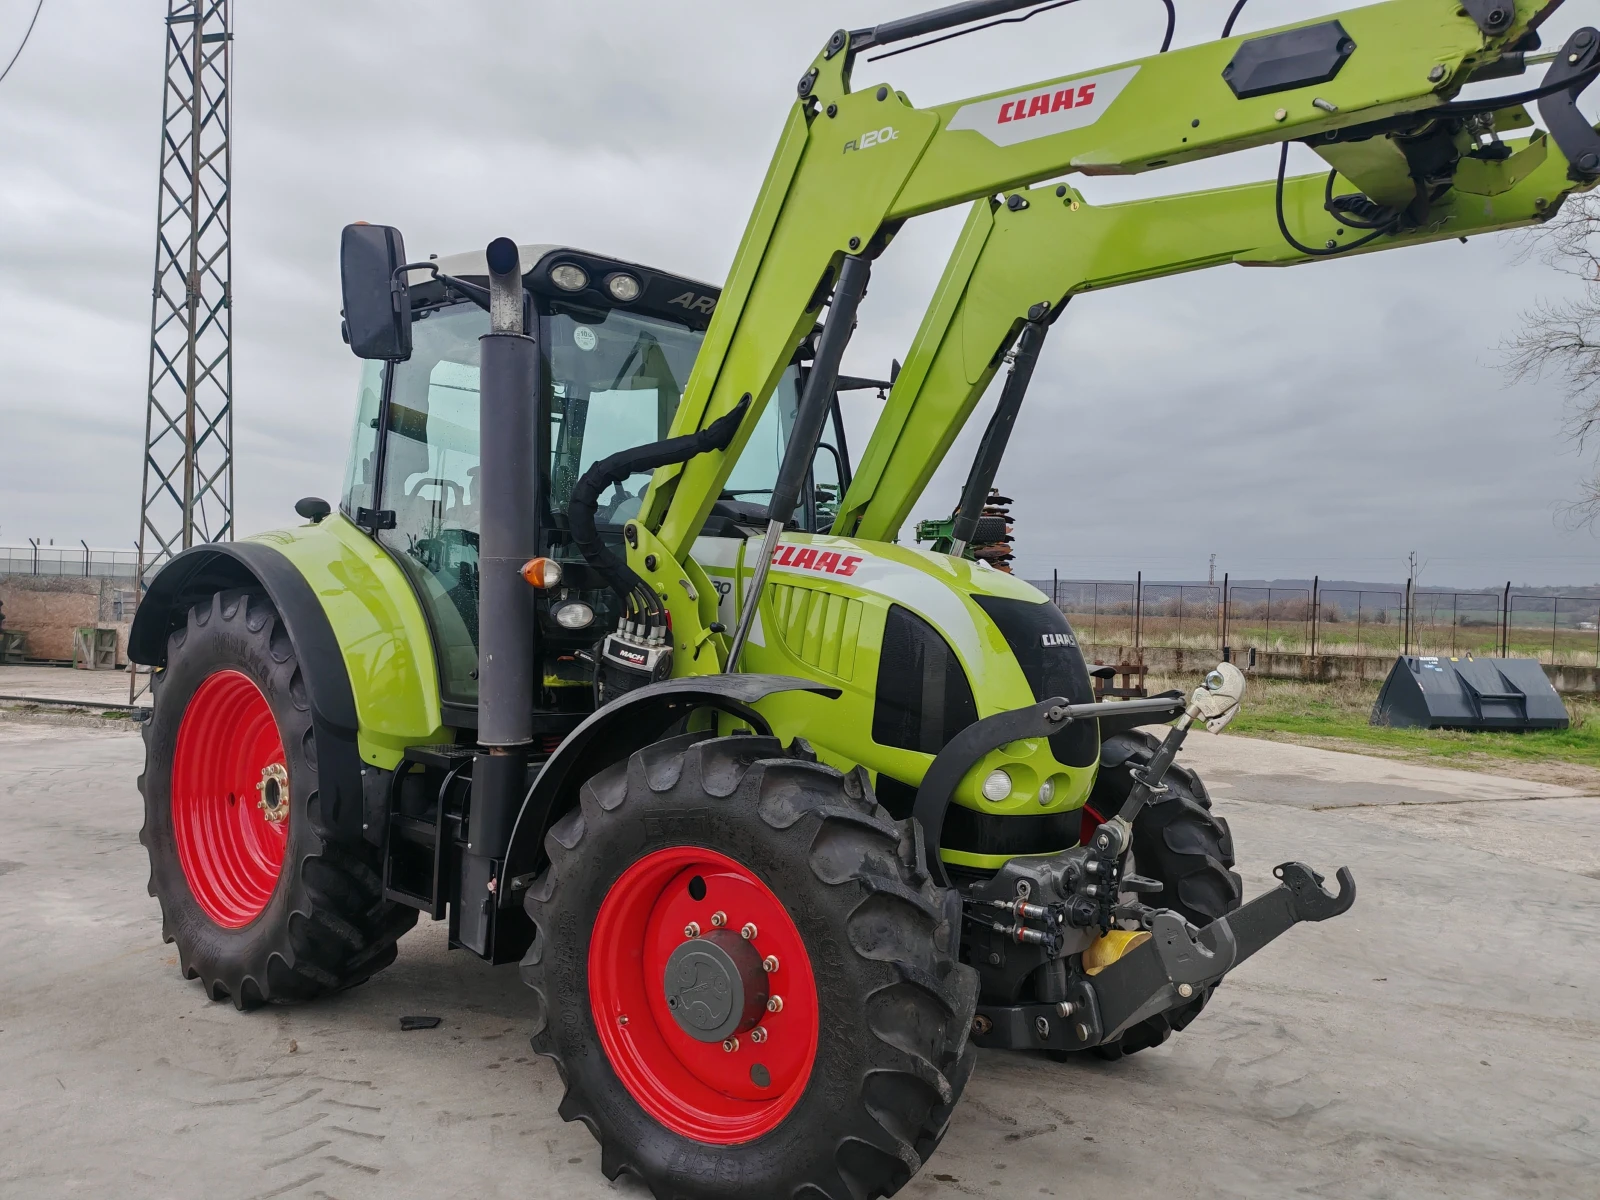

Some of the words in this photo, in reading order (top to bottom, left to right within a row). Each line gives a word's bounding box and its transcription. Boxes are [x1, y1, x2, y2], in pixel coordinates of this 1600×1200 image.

[997, 82, 1097, 124] CLAAS
[770, 545, 864, 577] CLAAS
[1041, 633, 1077, 646] CLAAS
[619, 649, 645, 661] MACH
